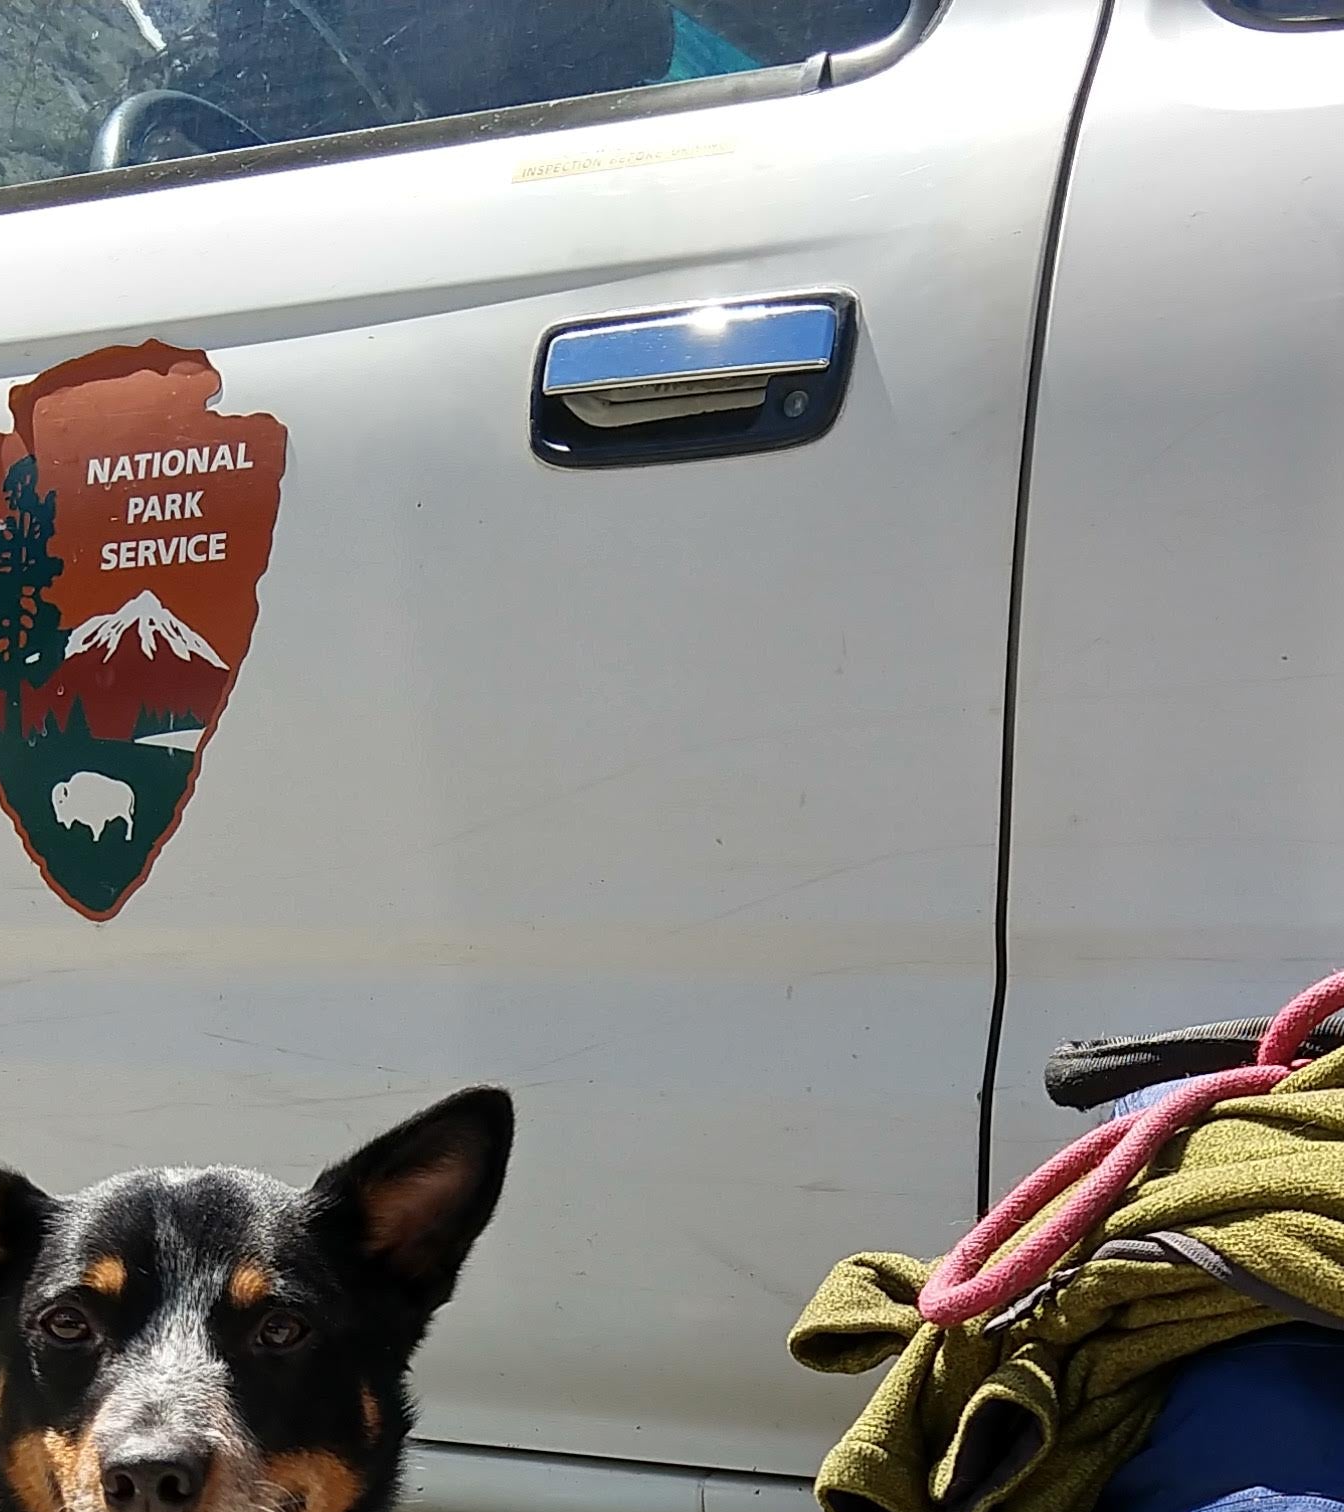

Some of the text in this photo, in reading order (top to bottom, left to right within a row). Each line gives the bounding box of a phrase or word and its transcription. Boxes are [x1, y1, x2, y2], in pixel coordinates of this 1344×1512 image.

[521, 157, 602, 178] INSPECTION
[87, 442, 254, 485] NATIONAL
[127, 490, 205, 524] PARK
[100, 532, 227, 571] SERVICE
